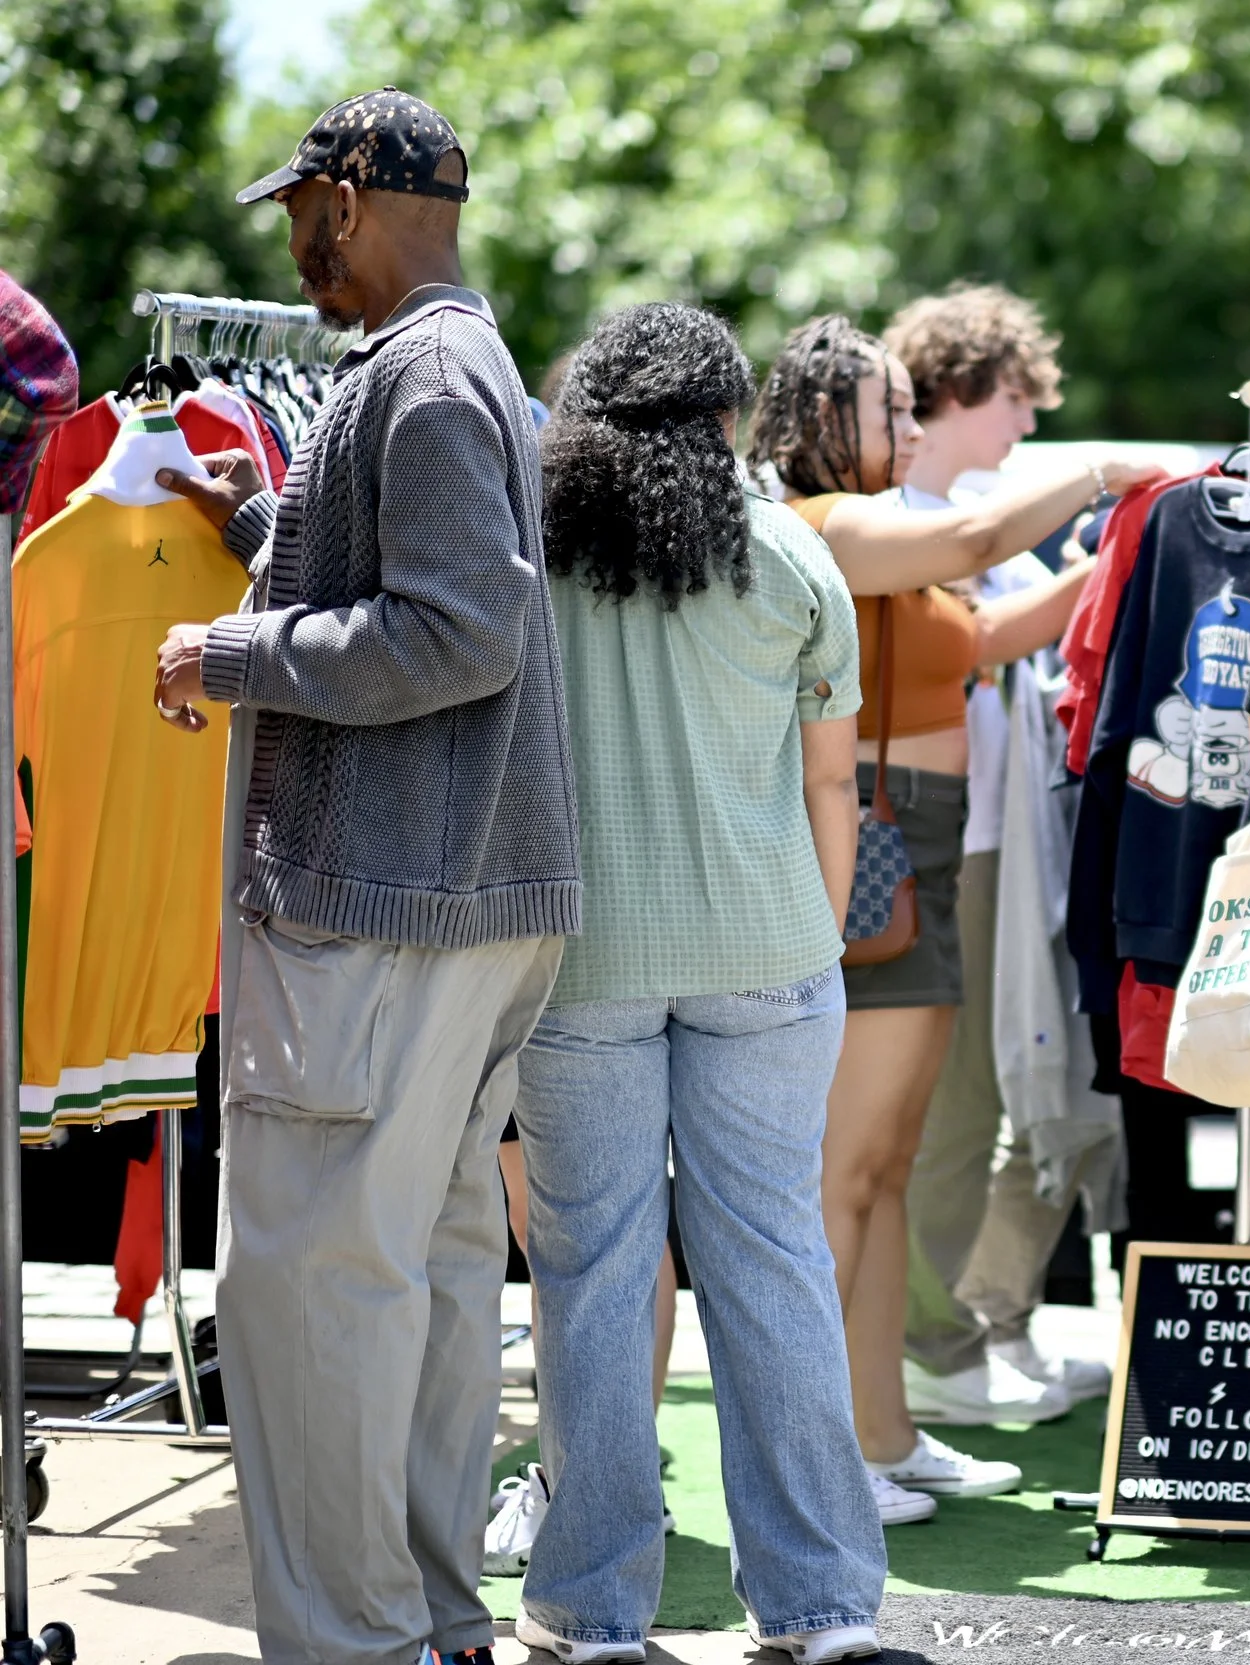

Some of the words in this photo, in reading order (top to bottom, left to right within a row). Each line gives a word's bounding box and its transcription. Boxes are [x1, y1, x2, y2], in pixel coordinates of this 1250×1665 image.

[1187, 1289, 1218, 1310] TO
[1155, 1319, 1190, 1340] NO
[1138, 1437, 1170, 1458] ON
